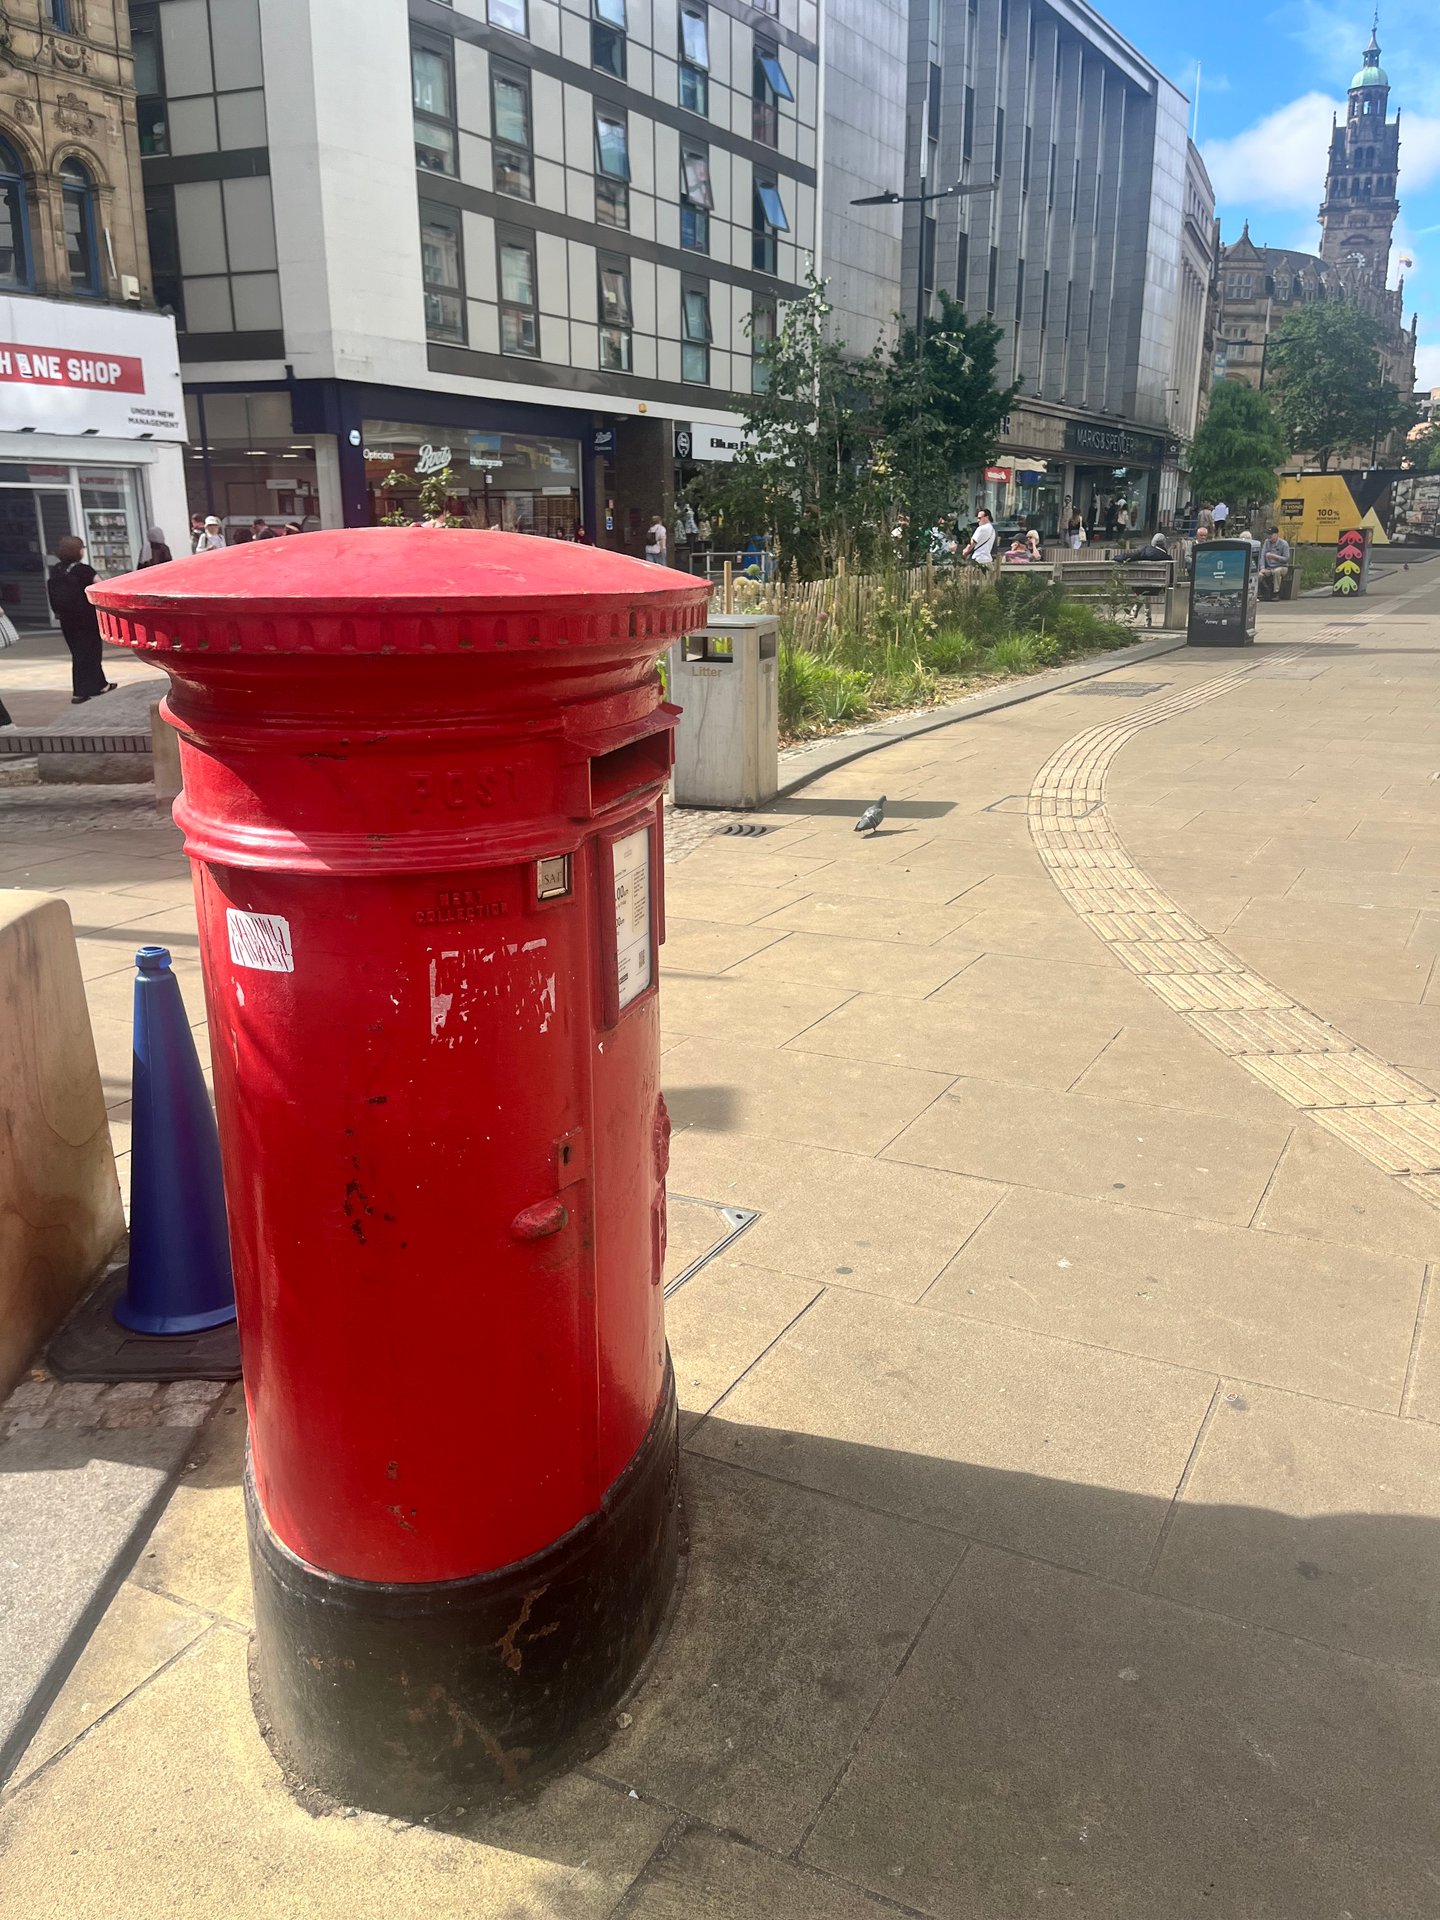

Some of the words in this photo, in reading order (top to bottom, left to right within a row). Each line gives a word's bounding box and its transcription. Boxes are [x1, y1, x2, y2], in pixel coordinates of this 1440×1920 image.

[67, 358, 122, 385] SHOP
[130, 407, 156, 417] UNDER
[157, 410, 175, 418] NEW
[128, 417, 180, 429] MANAGEMENT
[710, 438, 738, 450] Blue
[363, 449, 395, 461] Opticians
[414, 444, 452, 474] Boots
[692, 666, 722, 677] Litter
[407, 766, 525, 812] POST
[543, 871, 562, 885] SAT
[439, 888, 482, 905] NEXT
[415, 902, 509, 924] COLLECTION
